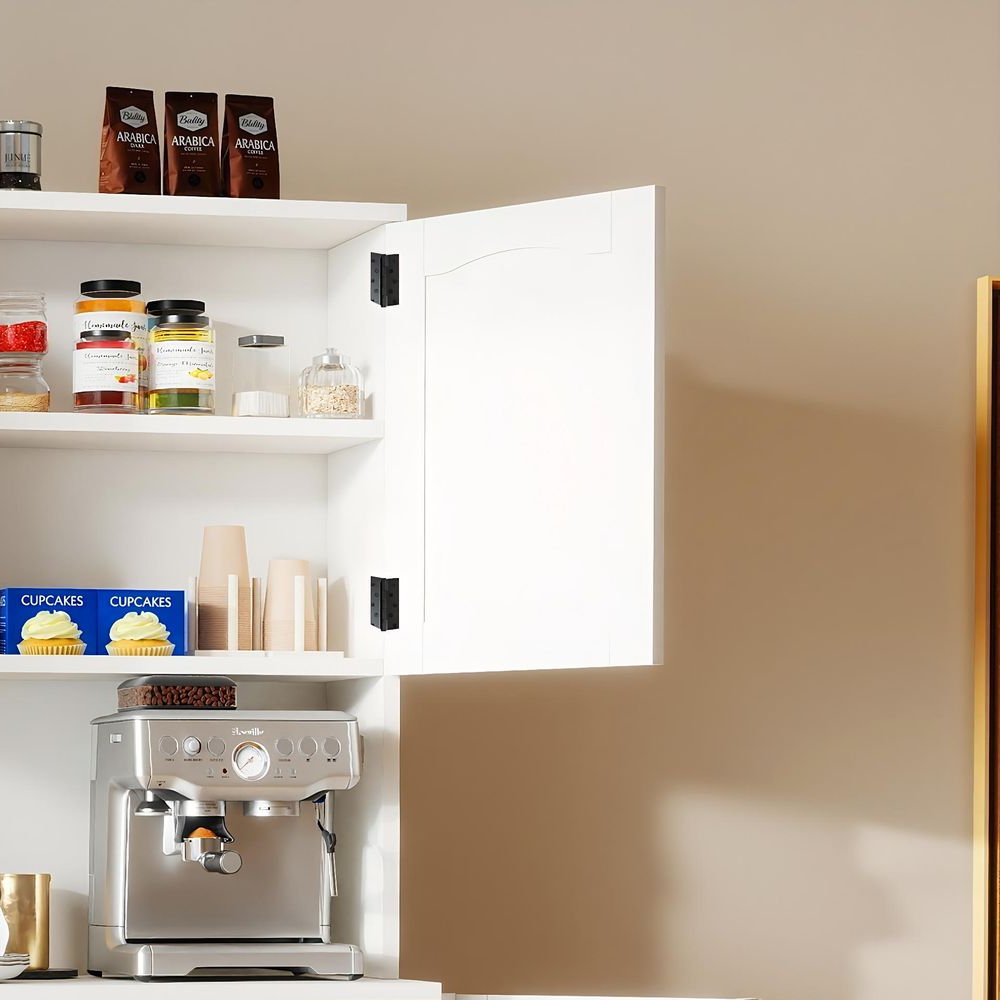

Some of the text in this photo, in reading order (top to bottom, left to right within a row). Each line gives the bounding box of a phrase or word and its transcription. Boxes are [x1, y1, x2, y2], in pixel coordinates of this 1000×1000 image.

[117, 131, 157, 145] ARABICA
[171, 135, 215, 147] ARABICA
[235, 138, 276, 151] ARABICA
[21, 594, 84, 606] CUPCAKES
[110, 596, 172, 608] CUPCAKES
